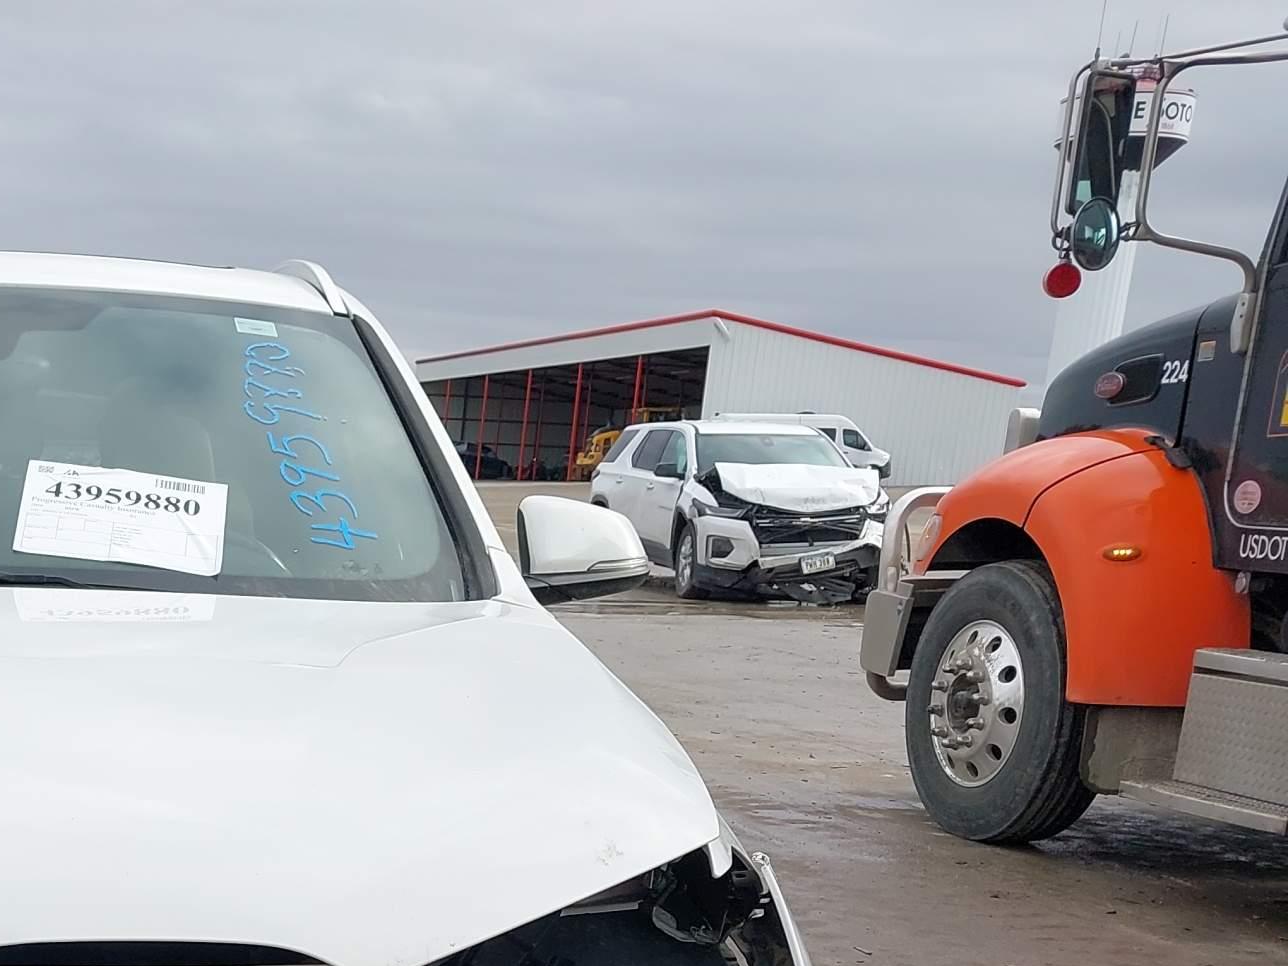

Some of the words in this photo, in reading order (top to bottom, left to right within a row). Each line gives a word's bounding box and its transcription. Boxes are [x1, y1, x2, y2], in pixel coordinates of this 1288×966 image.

[1161, 360, 1189, 384] 224
[45, 481, 201, 516] 43959880
[1239, 534, 1288, 560] USDOT
